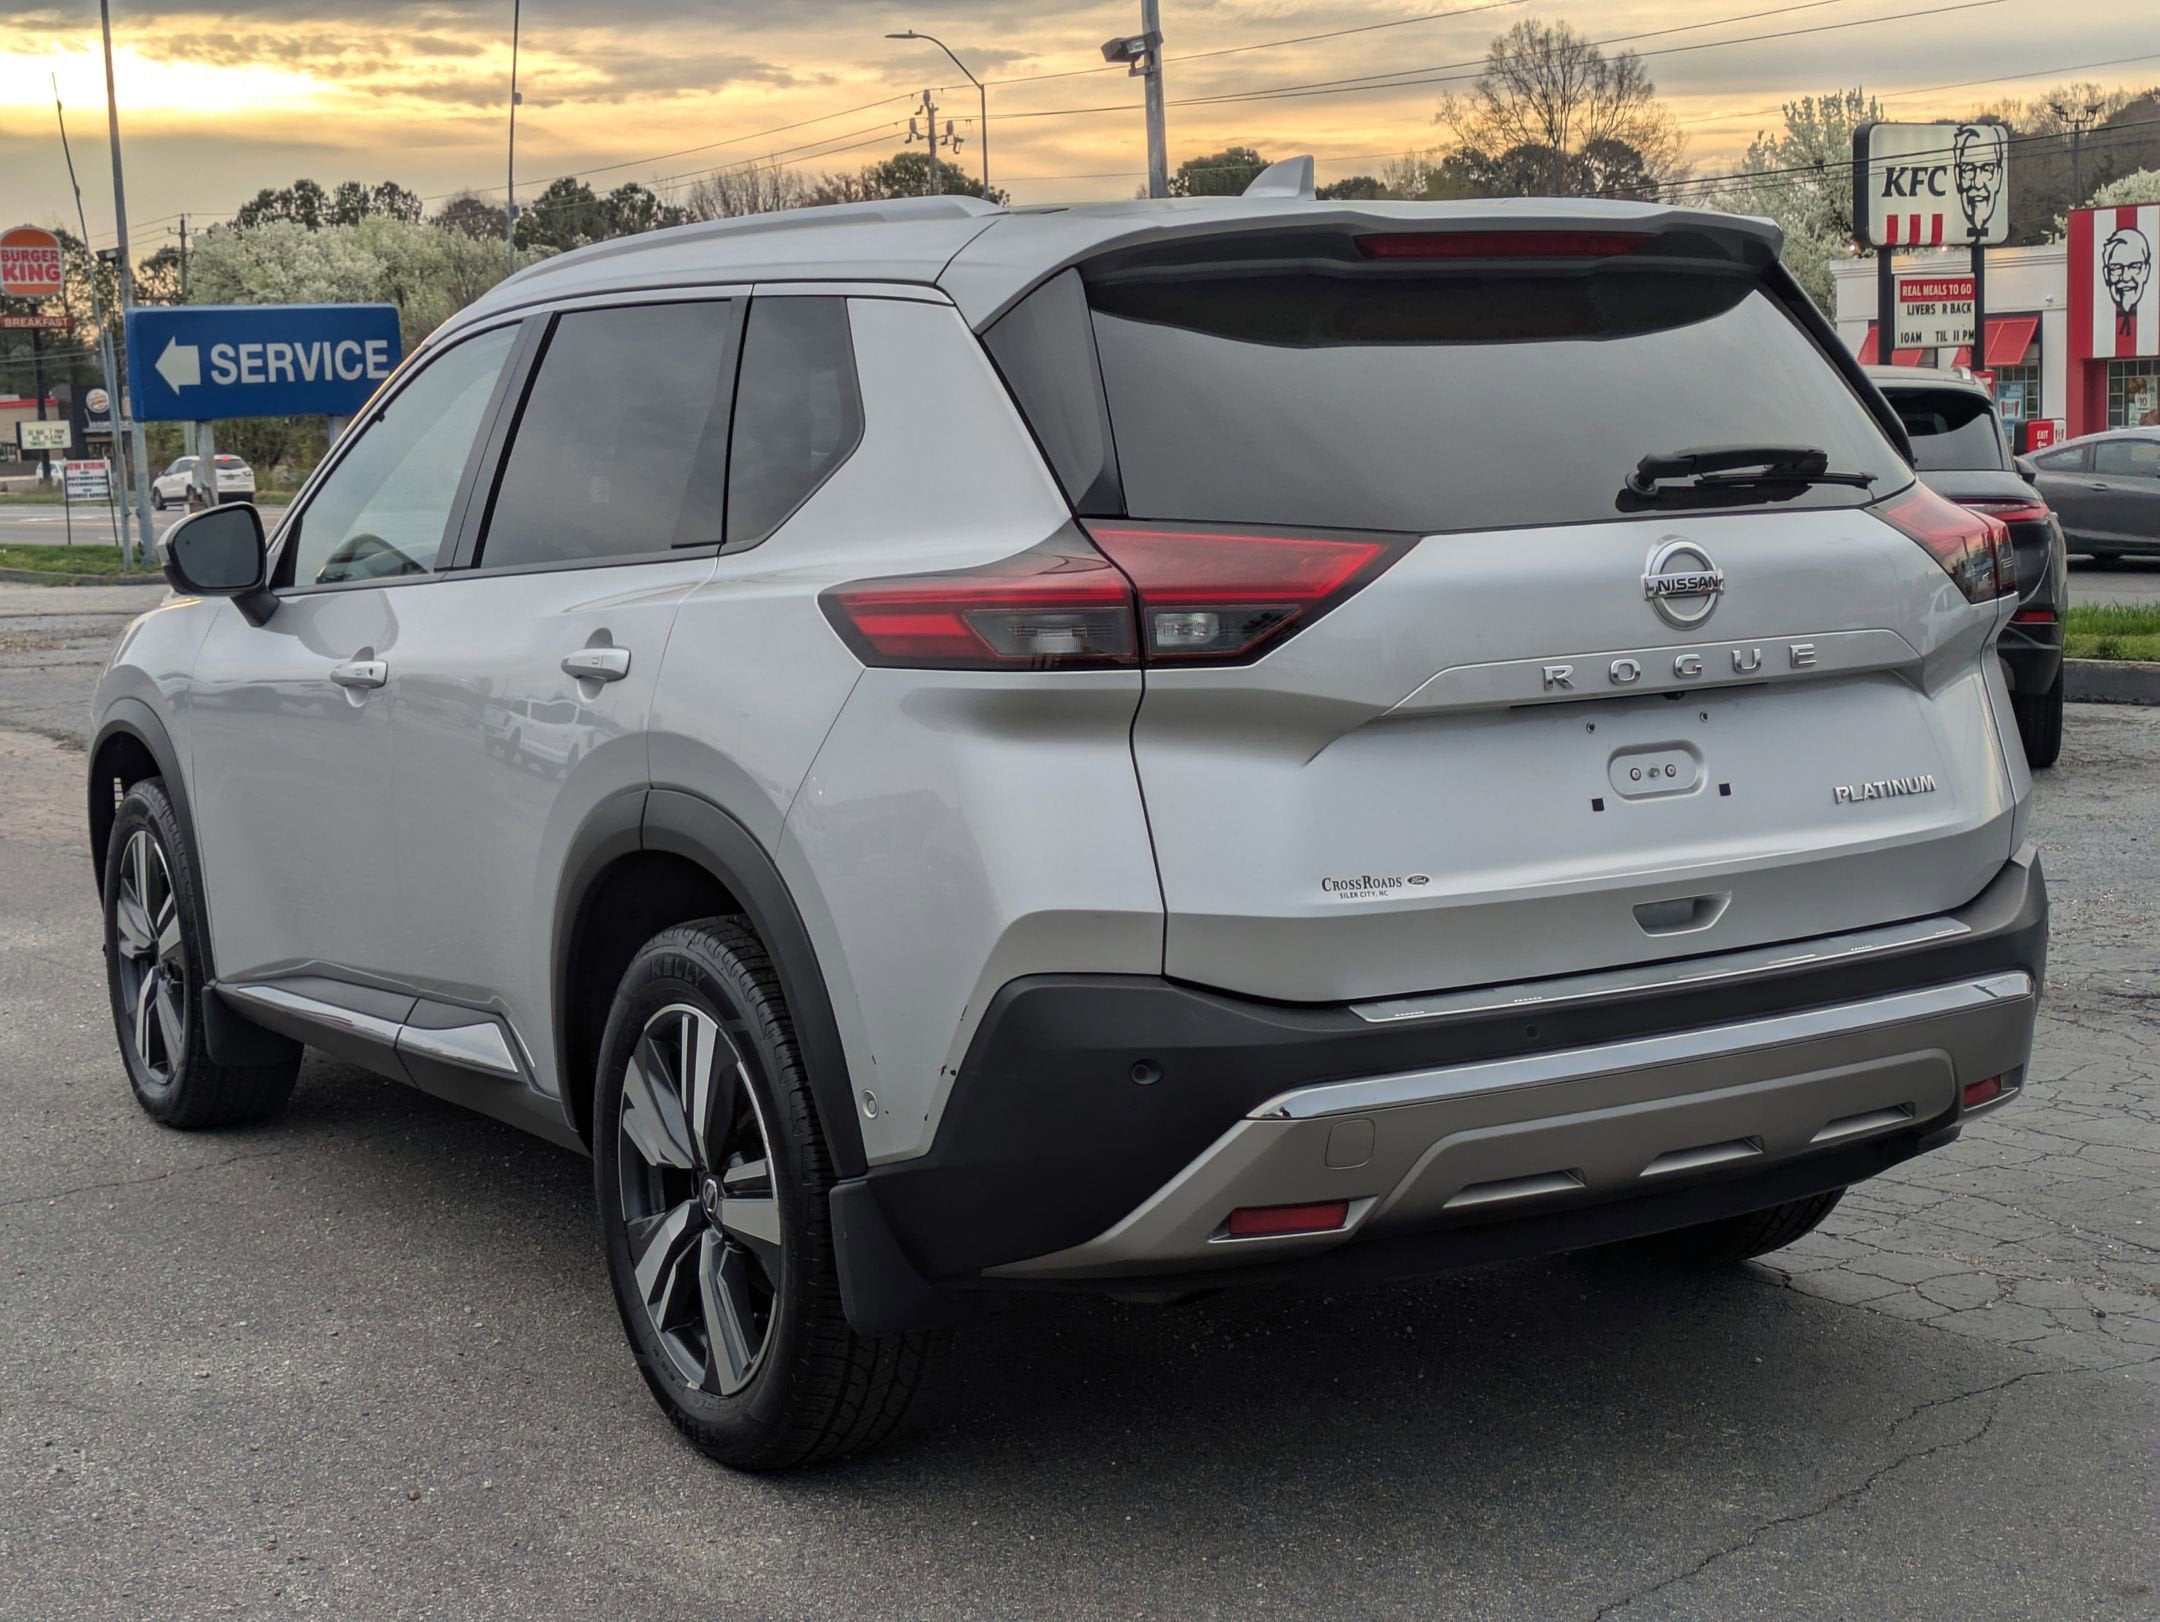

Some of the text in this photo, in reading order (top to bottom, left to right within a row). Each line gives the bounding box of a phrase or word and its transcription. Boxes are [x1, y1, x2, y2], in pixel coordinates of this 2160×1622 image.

[1881, 166, 1947, 197] KFC
[0, 249, 59, 263] BURGER
[2, 264, 61, 282] KING
[1902, 283, 1972, 297] REAL MEALS TO GO
[1907, 302, 1972, 316] LIVERS R BACK
[4, 317, 68, 328] BREAKFAST
[1936, 331, 1948, 342] TIL
[1963, 329, 1975, 341] PM
[210, 340, 391, 385] SERVICE
[2037, 430, 2048, 439] EXIT
[1658, 575, 1719, 592] NISSAN
[1542, 643, 1818, 691] ROGUE
[1834, 775, 1937, 804] PLATINUM
[1339, 891, 1358, 899] SILER
[648, 955, 705, 987] KELLY
